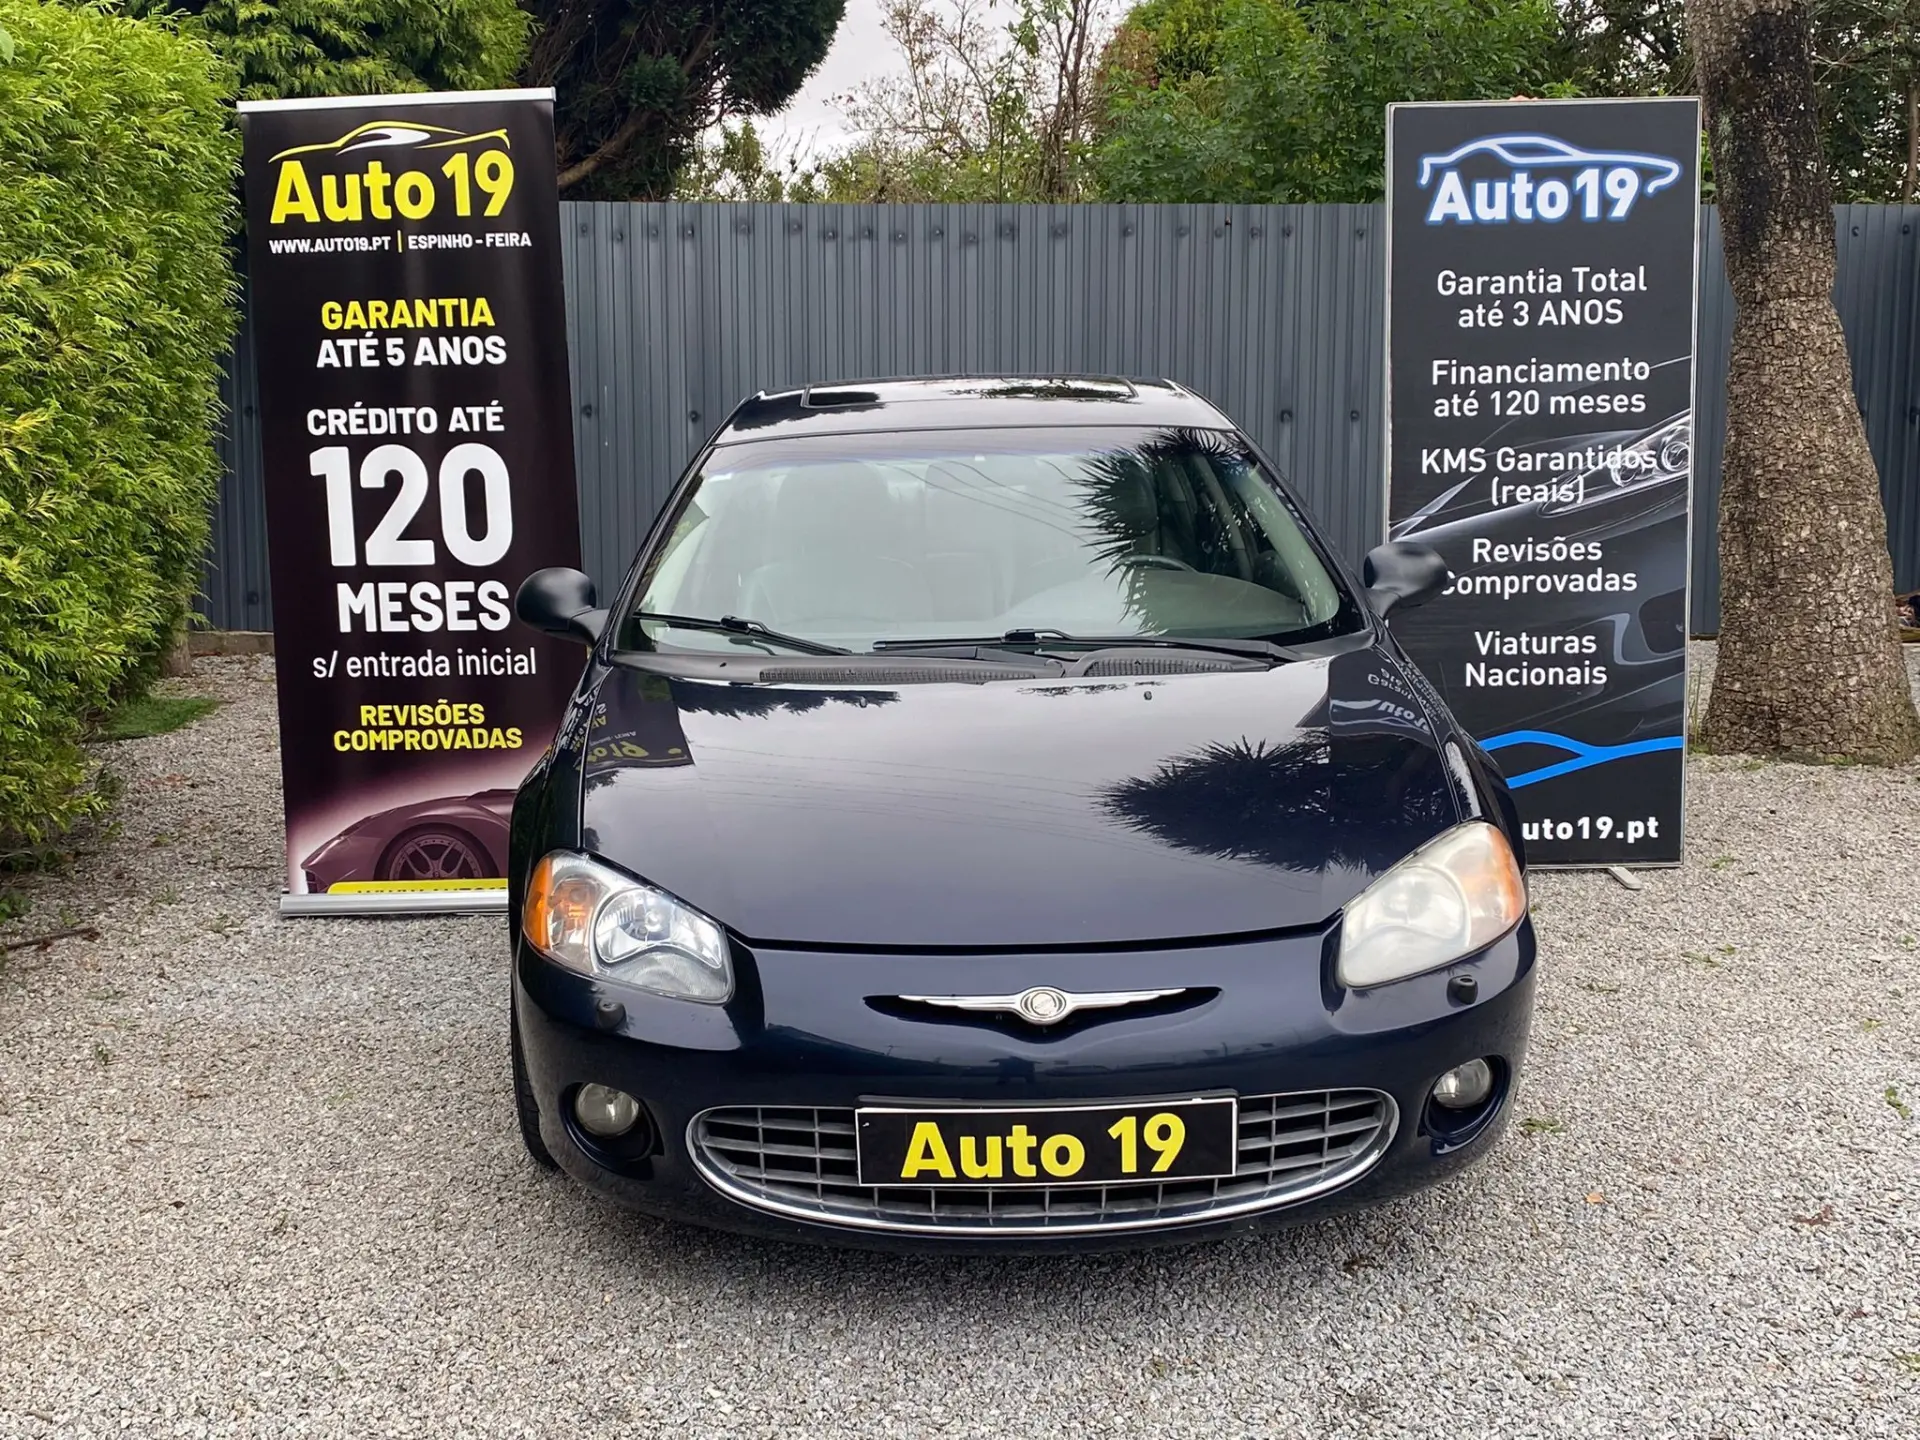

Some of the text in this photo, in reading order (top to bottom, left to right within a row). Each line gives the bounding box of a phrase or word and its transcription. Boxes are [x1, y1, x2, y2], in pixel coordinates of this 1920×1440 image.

[270, 150, 514, 224] Auto 19
[1427, 166, 1641, 222] Auto19
[269, 237, 391, 253] WWW.AUTO19.PT
[408, 234, 472, 249] ESPINHO
[486, 233, 531, 247] FEIRA
[1438, 266, 1647, 295] Garantia Total
[322, 298, 495, 330] GARANTIA
[1459, 299, 1623, 327] até 3 ANOS
[317, 331, 506, 367] ATÉ 5 ANOS
[1433, 358, 1651, 385] Financiamento
[308, 400, 504, 435] CRÉDITO ATÉ
[1434, 390, 1645, 417] até 120 meses
[1422, 445, 1657, 474] KMS Garantidos
[310, 443, 512, 566] 120
[1491, 475, 1585, 506] (reais)
[1473, 536, 1602, 562] Revisões
[337, 581, 510, 632] MESES
[1475, 631, 1596, 655] Viaturas
[313, 648, 535, 677] s/ entrada inicial
[1466, 660, 1607, 686] Nacionais
[361, 699, 484, 726] REVISÕES
[334, 728, 522, 751] COMPROVADAS
[1523, 817, 1658, 843] uto19.pt
[901, 1112, 1186, 1178] Auto 19
